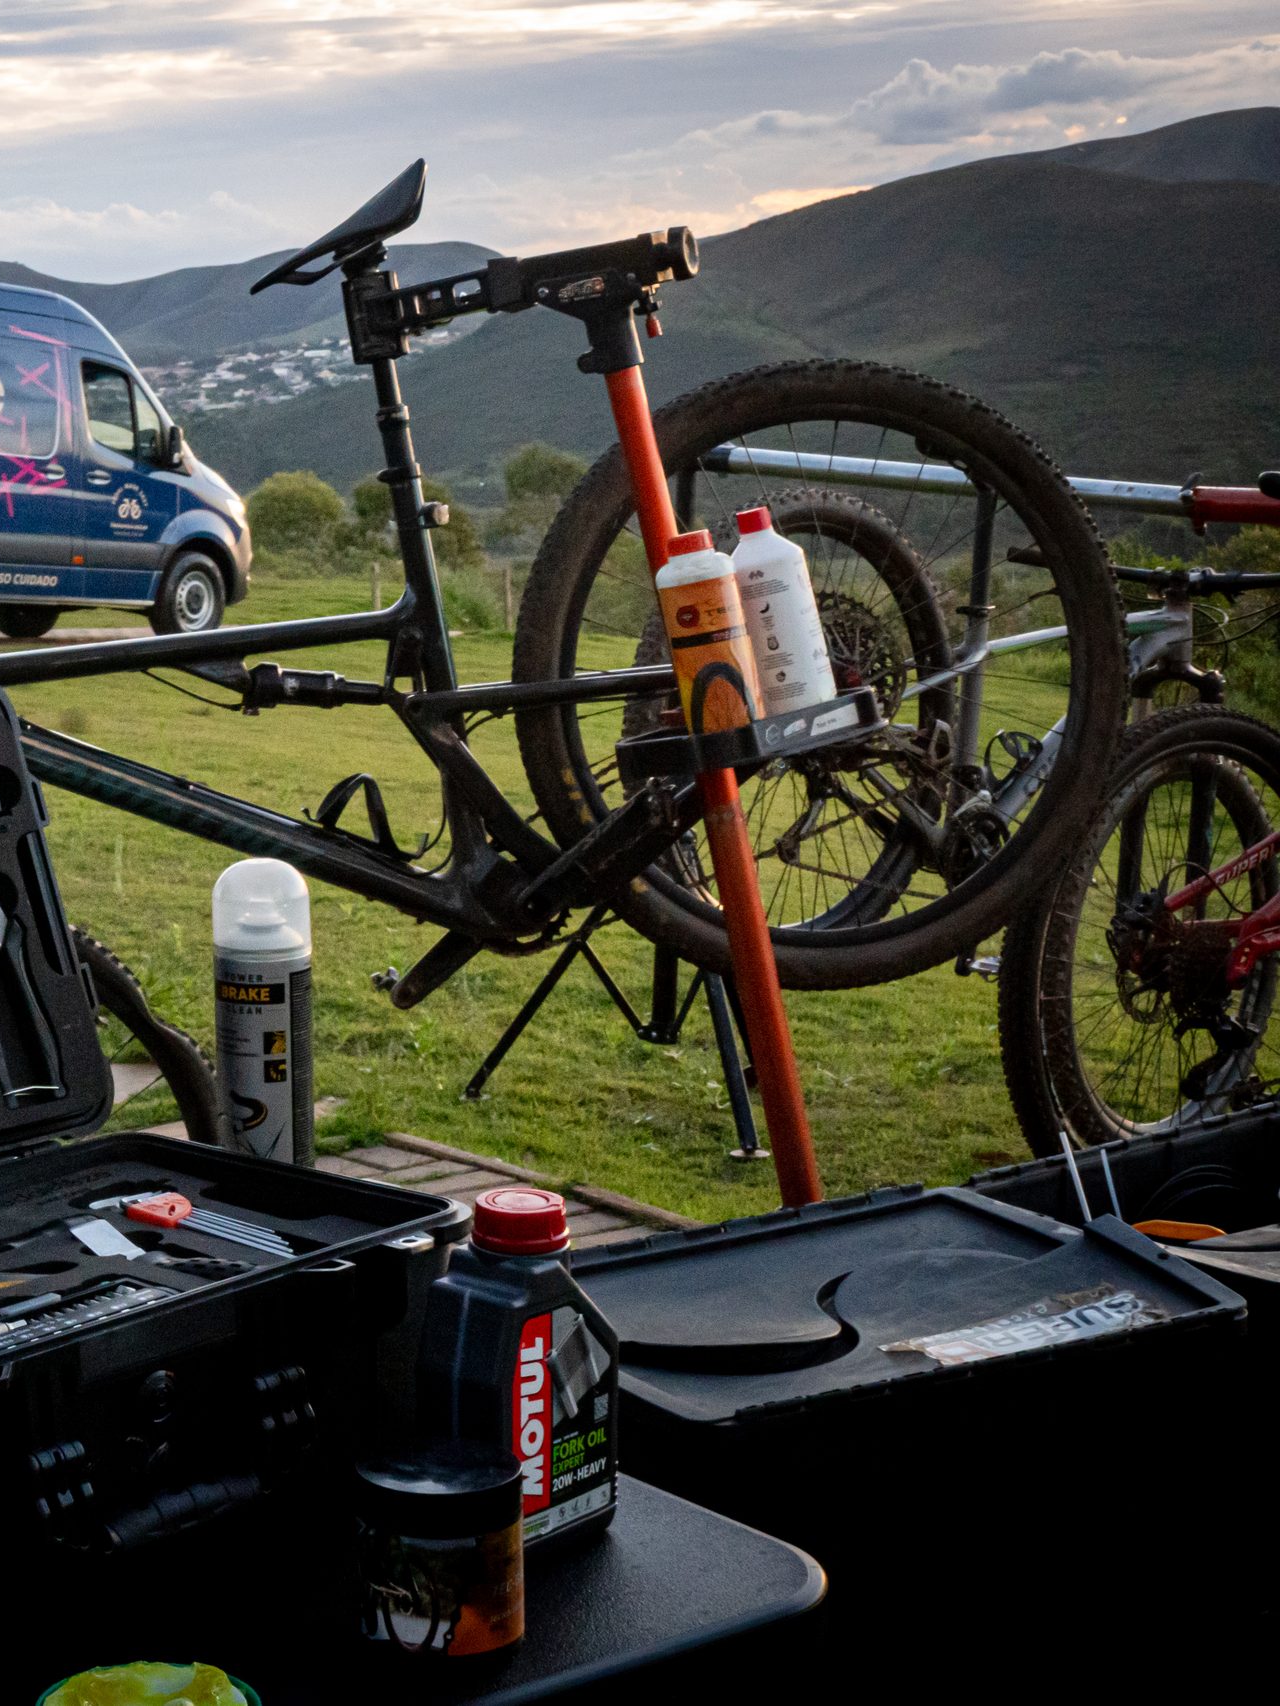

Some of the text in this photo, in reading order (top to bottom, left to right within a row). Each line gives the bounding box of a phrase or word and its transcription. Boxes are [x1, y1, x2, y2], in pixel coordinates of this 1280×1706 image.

[13, 573, 58, 587] CUIDADO
[221, 984, 271, 1002] BRAKE
[520, 1336, 545, 1497] MOTUL
[552, 1435, 585, 1462] FORK
[587, 1427, 607, 1448] OIL
[552, 1452, 585, 1476] EXPERT
[552, 1456, 607, 1492] 20W-HEAVY
